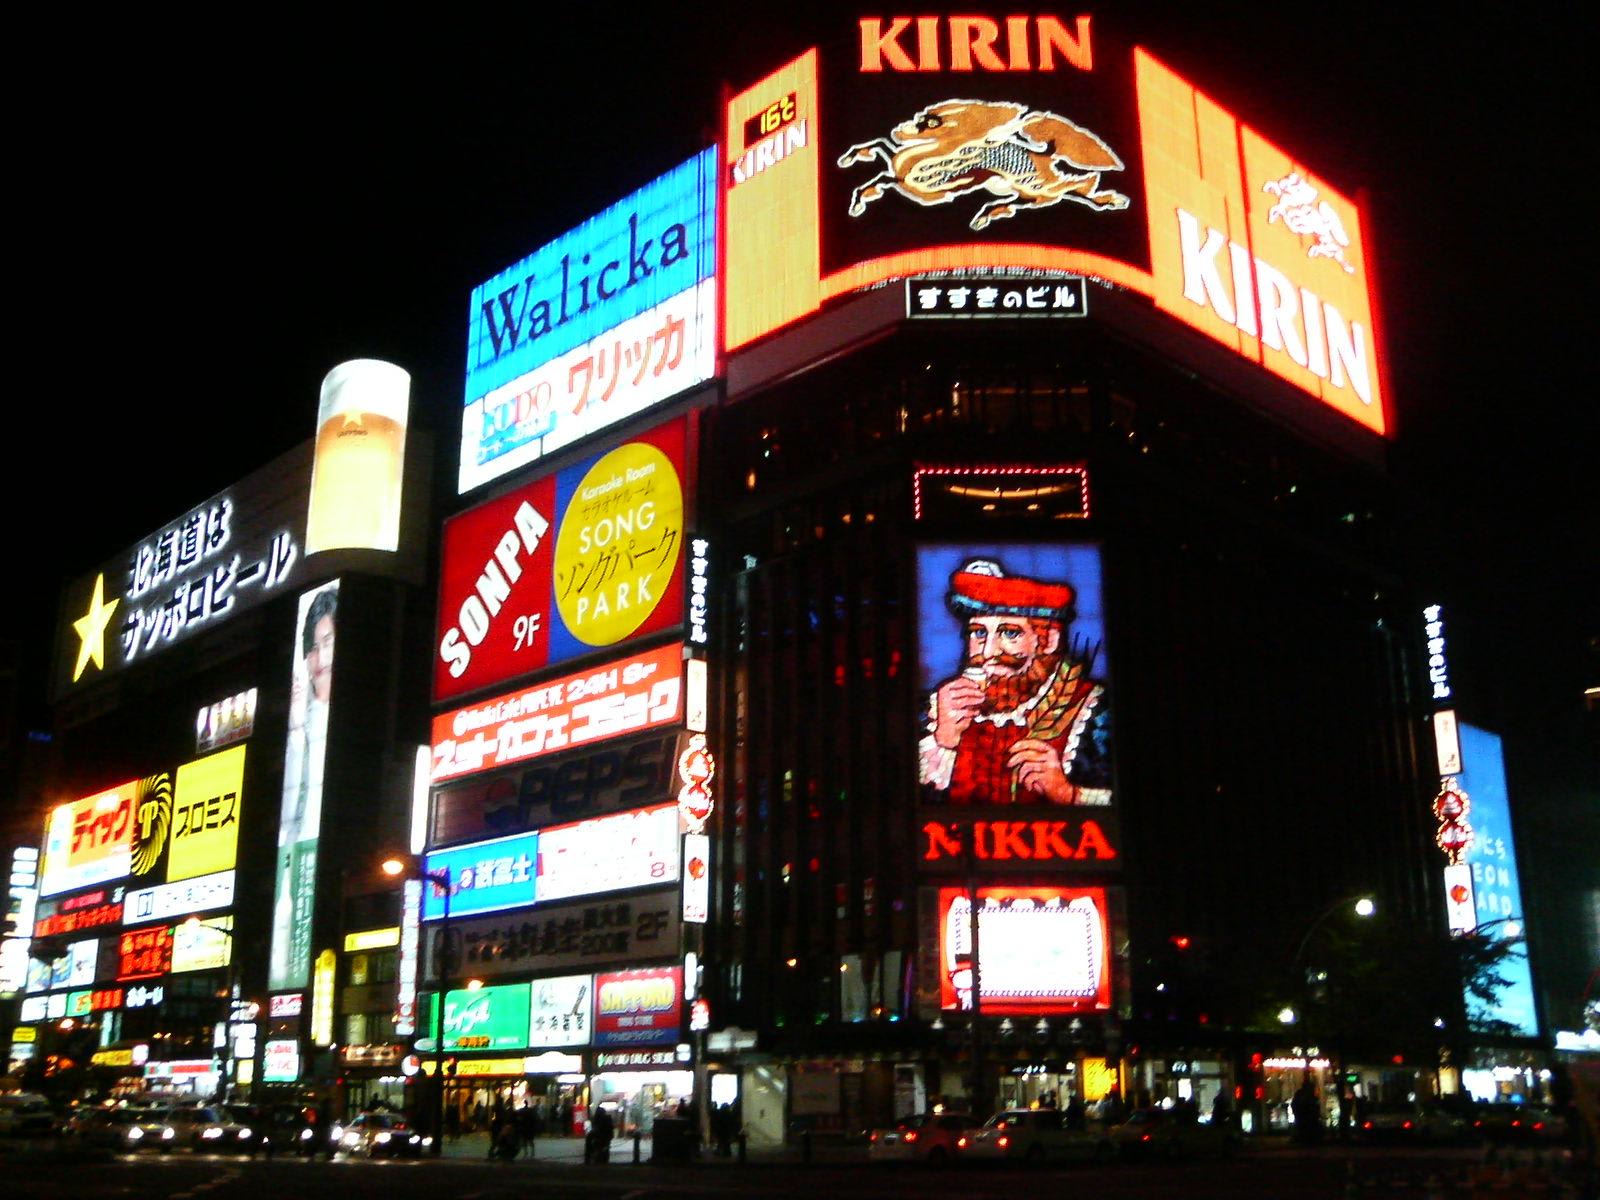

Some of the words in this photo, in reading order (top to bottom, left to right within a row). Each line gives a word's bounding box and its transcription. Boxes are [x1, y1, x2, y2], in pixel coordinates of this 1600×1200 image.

[858, 15, 1093, 72] KIRIN
[733, 118, 807, 184] KIRIN
[481, 211, 690, 361] Walicka
[917, 284, 1076, 310] すすきのビル
[1175, 207, 1372, 406] KIRIN
[567, 313, 687, 416] ワリッカ
[581, 474, 625, 502] Karaoke
[126, 499, 233, 598] 北海道は
[579, 501, 656, 554] SONG
[439, 499, 550, 679] SONPA
[558, 526, 679, 600] ソングパーク
[121, 530, 298, 662] サッポロビール
[575, 573, 653, 626] PARK
[512, 612, 541, 652] 9F
[566, 667, 618, 702] 24H
[922, 820, 1116, 861] NIKKA
